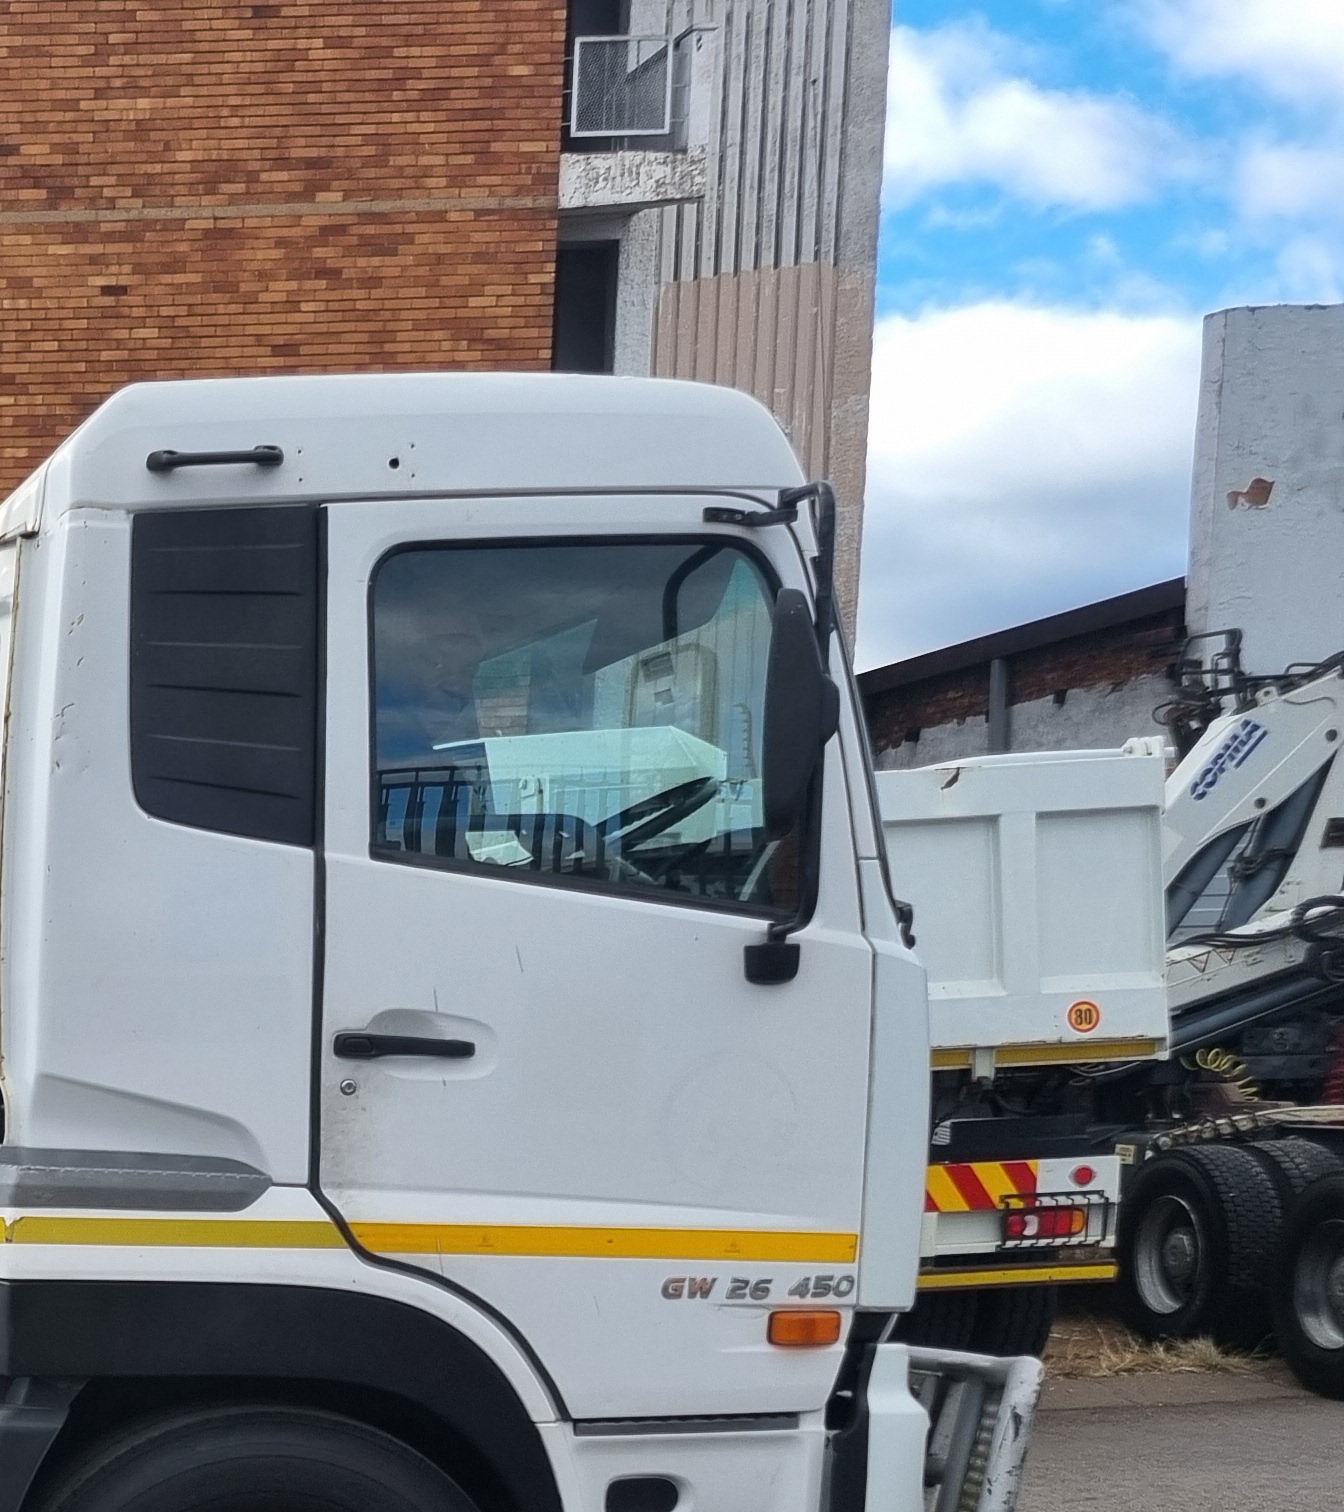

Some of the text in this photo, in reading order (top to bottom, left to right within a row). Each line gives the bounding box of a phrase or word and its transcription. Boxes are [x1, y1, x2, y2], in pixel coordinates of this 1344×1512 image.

[1074, 1008, 1093, 1025] 80
[661, 1274, 855, 1300] GW 26 450
